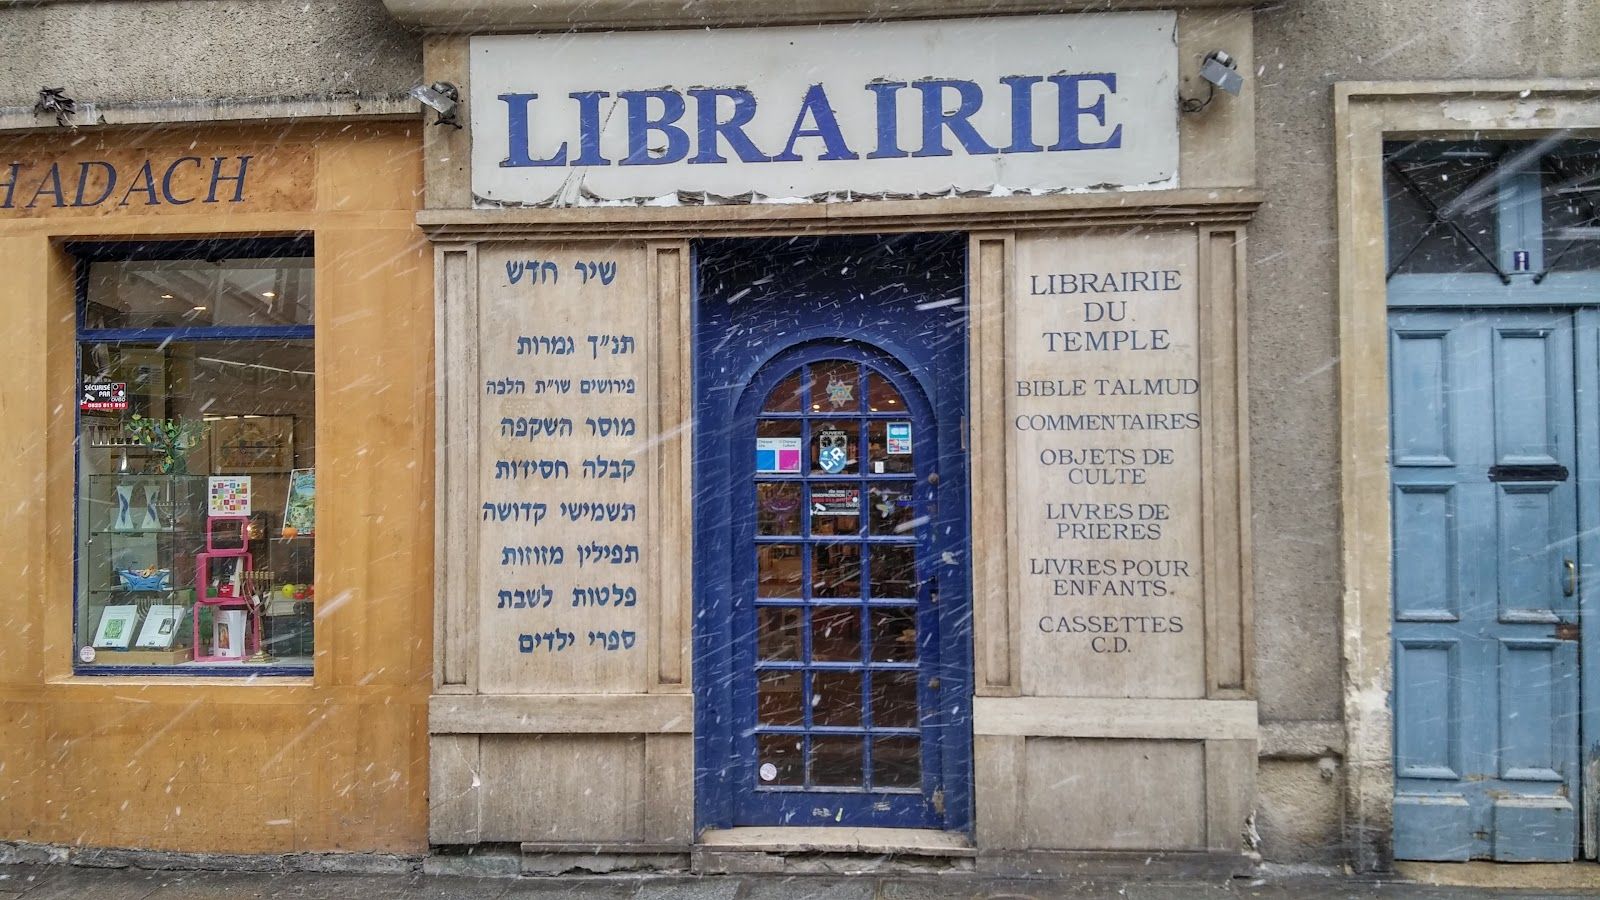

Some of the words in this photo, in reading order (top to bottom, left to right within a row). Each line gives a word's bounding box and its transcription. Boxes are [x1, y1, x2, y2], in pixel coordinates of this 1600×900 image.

[497, 71, 1123, 168] LIBRAIRIE
[505, 259, 558, 285] חדש
[574, 260, 617, 286] שיר
[1029, 270, 1182, 296] LIBRAIRIE
[1083, 301, 1128, 323] DU
[516, 335, 575, 355] גמרות
[1042, 329, 1171, 353] TEMPLE
[486, 376, 526, 395] הלכה
[580, 378, 636, 394] פירושים
[1016, 379, 1087, 397] BIBLE
[1094, 378, 1199, 396] TALMUD
[500, 416, 573, 442] השקפה
[585, 416, 636, 438] מוסר
[1015, 413, 1201, 431] COMMENTAIRES
[1040, 448, 1136, 466] OBJETS
[1142, 448, 1175, 466] DE
[582, 454, 637, 483] קבלה
[1068, 468, 1147, 485] CULTE
[482, 501, 547, 527] קדושה
[559, 502, 636, 522] תשמישי
[1046, 503, 1134, 520] LIVRES
[1138, 503, 1170, 521] DE
[1056, 523, 1162, 540] PRIERES
[501, 545, 564, 566] מזוזות
[576, 540, 640, 568] תפילין
[1029, 558, 1117, 576] LIVRES
[1122, 559, 1190, 577] POUR
[497, 584, 554, 609] לשבת
[572, 582, 637, 607] פלטות
[1038, 616, 1184, 633] CASSETTES
[518, 628, 576, 653] ילדים
[588, 629, 636, 651] ספרי
[1091, 637, 1132, 653] C.D.
